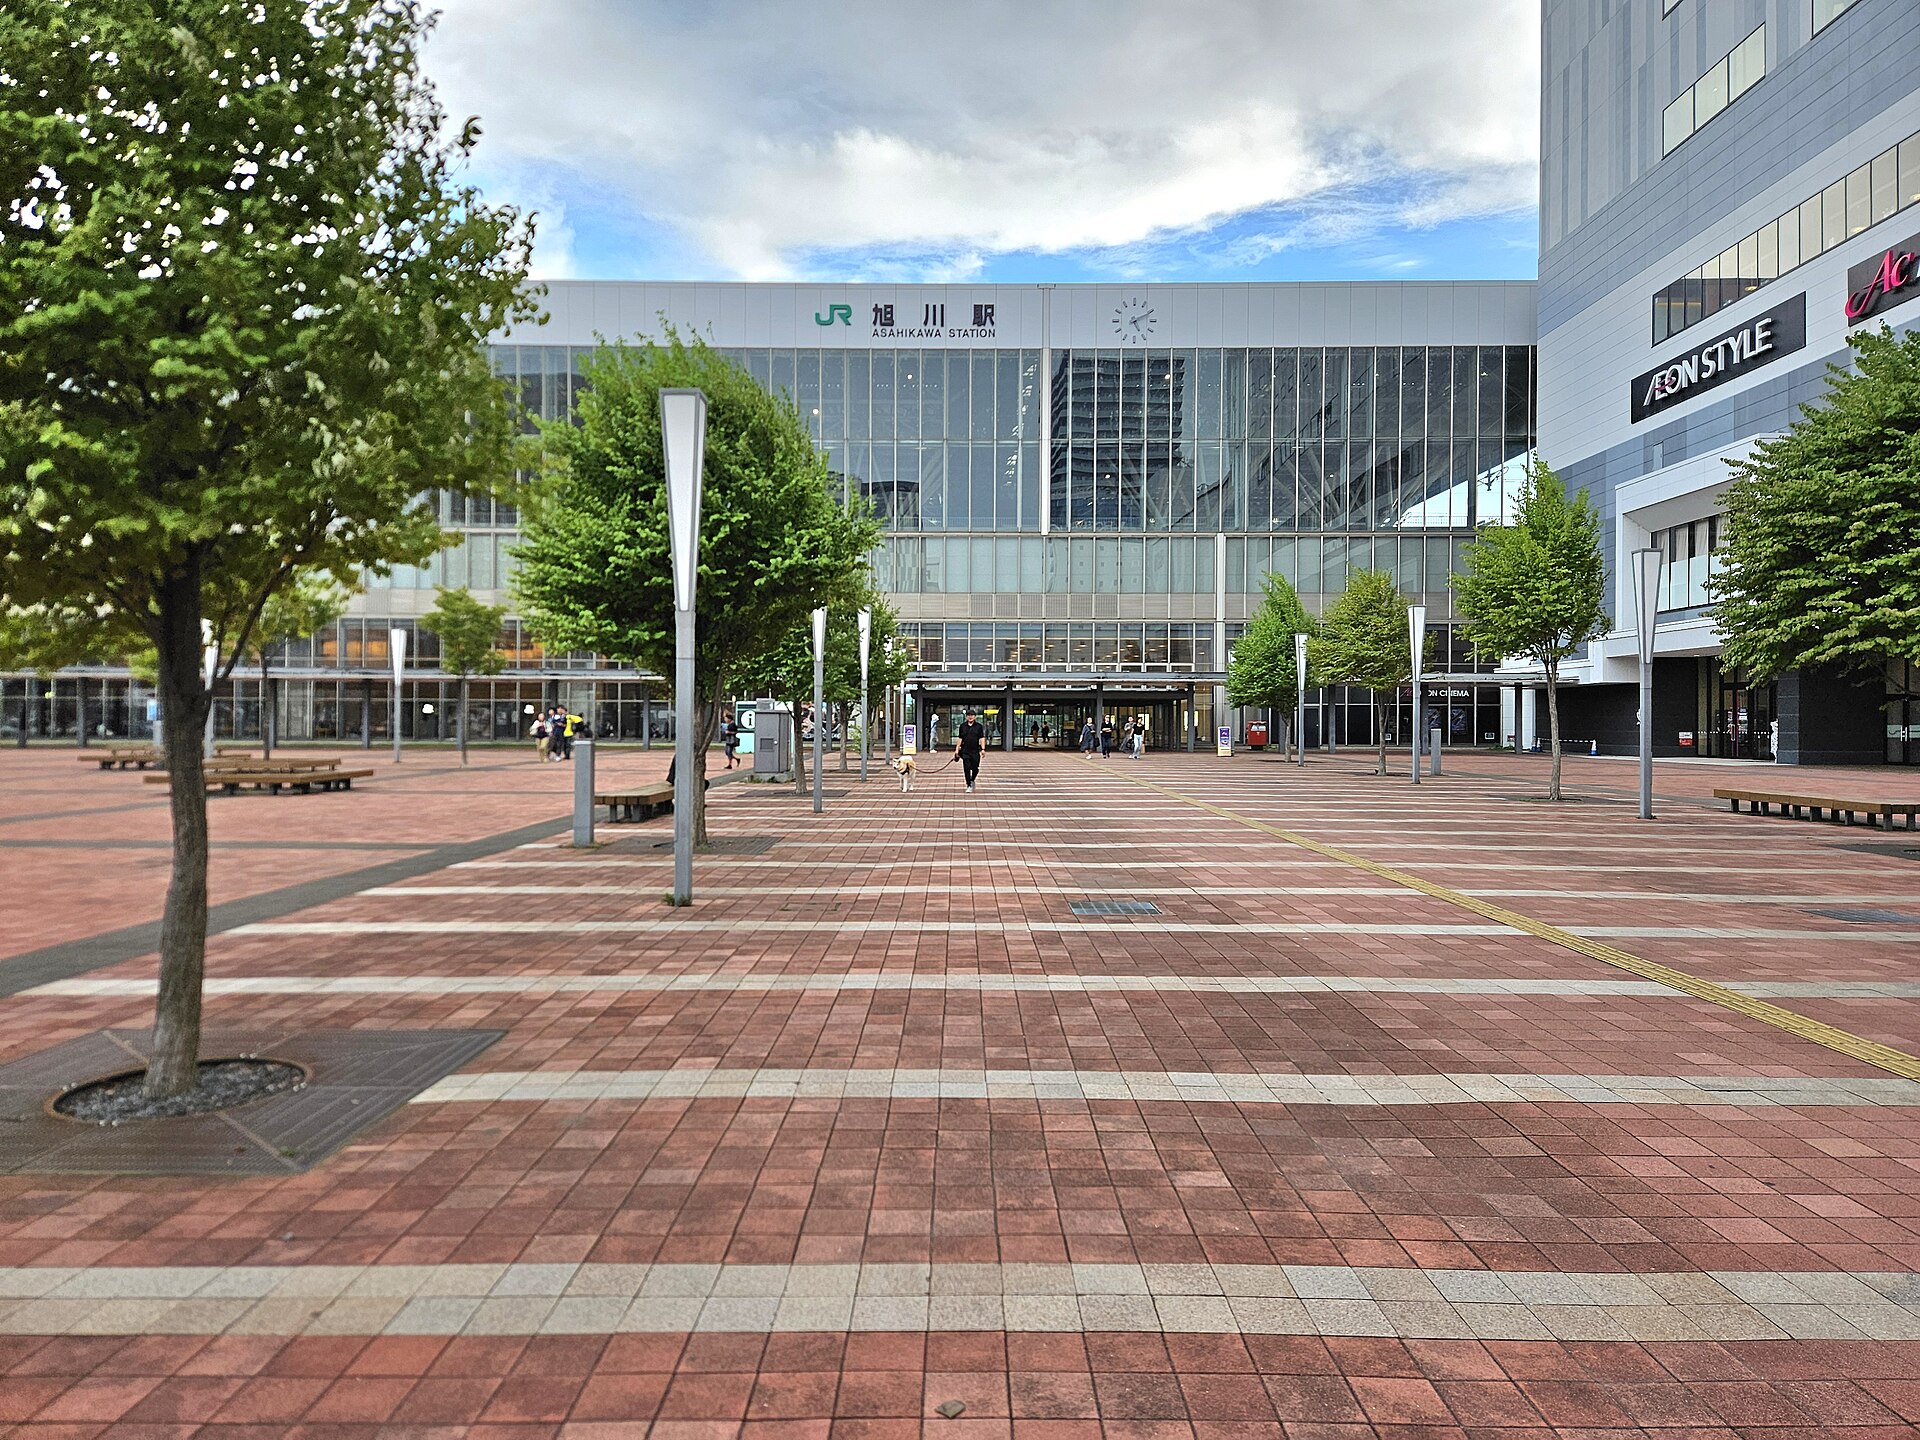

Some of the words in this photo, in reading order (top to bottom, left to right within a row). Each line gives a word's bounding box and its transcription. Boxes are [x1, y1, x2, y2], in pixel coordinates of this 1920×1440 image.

[815, 304, 852, 326] JR
[872, 303, 995, 327] 旭川駅
[872, 328, 942, 338] ASAHIKAWA
[948, 328, 996, 338] STATION
[1701, 317, 1773, 379] STYLE
